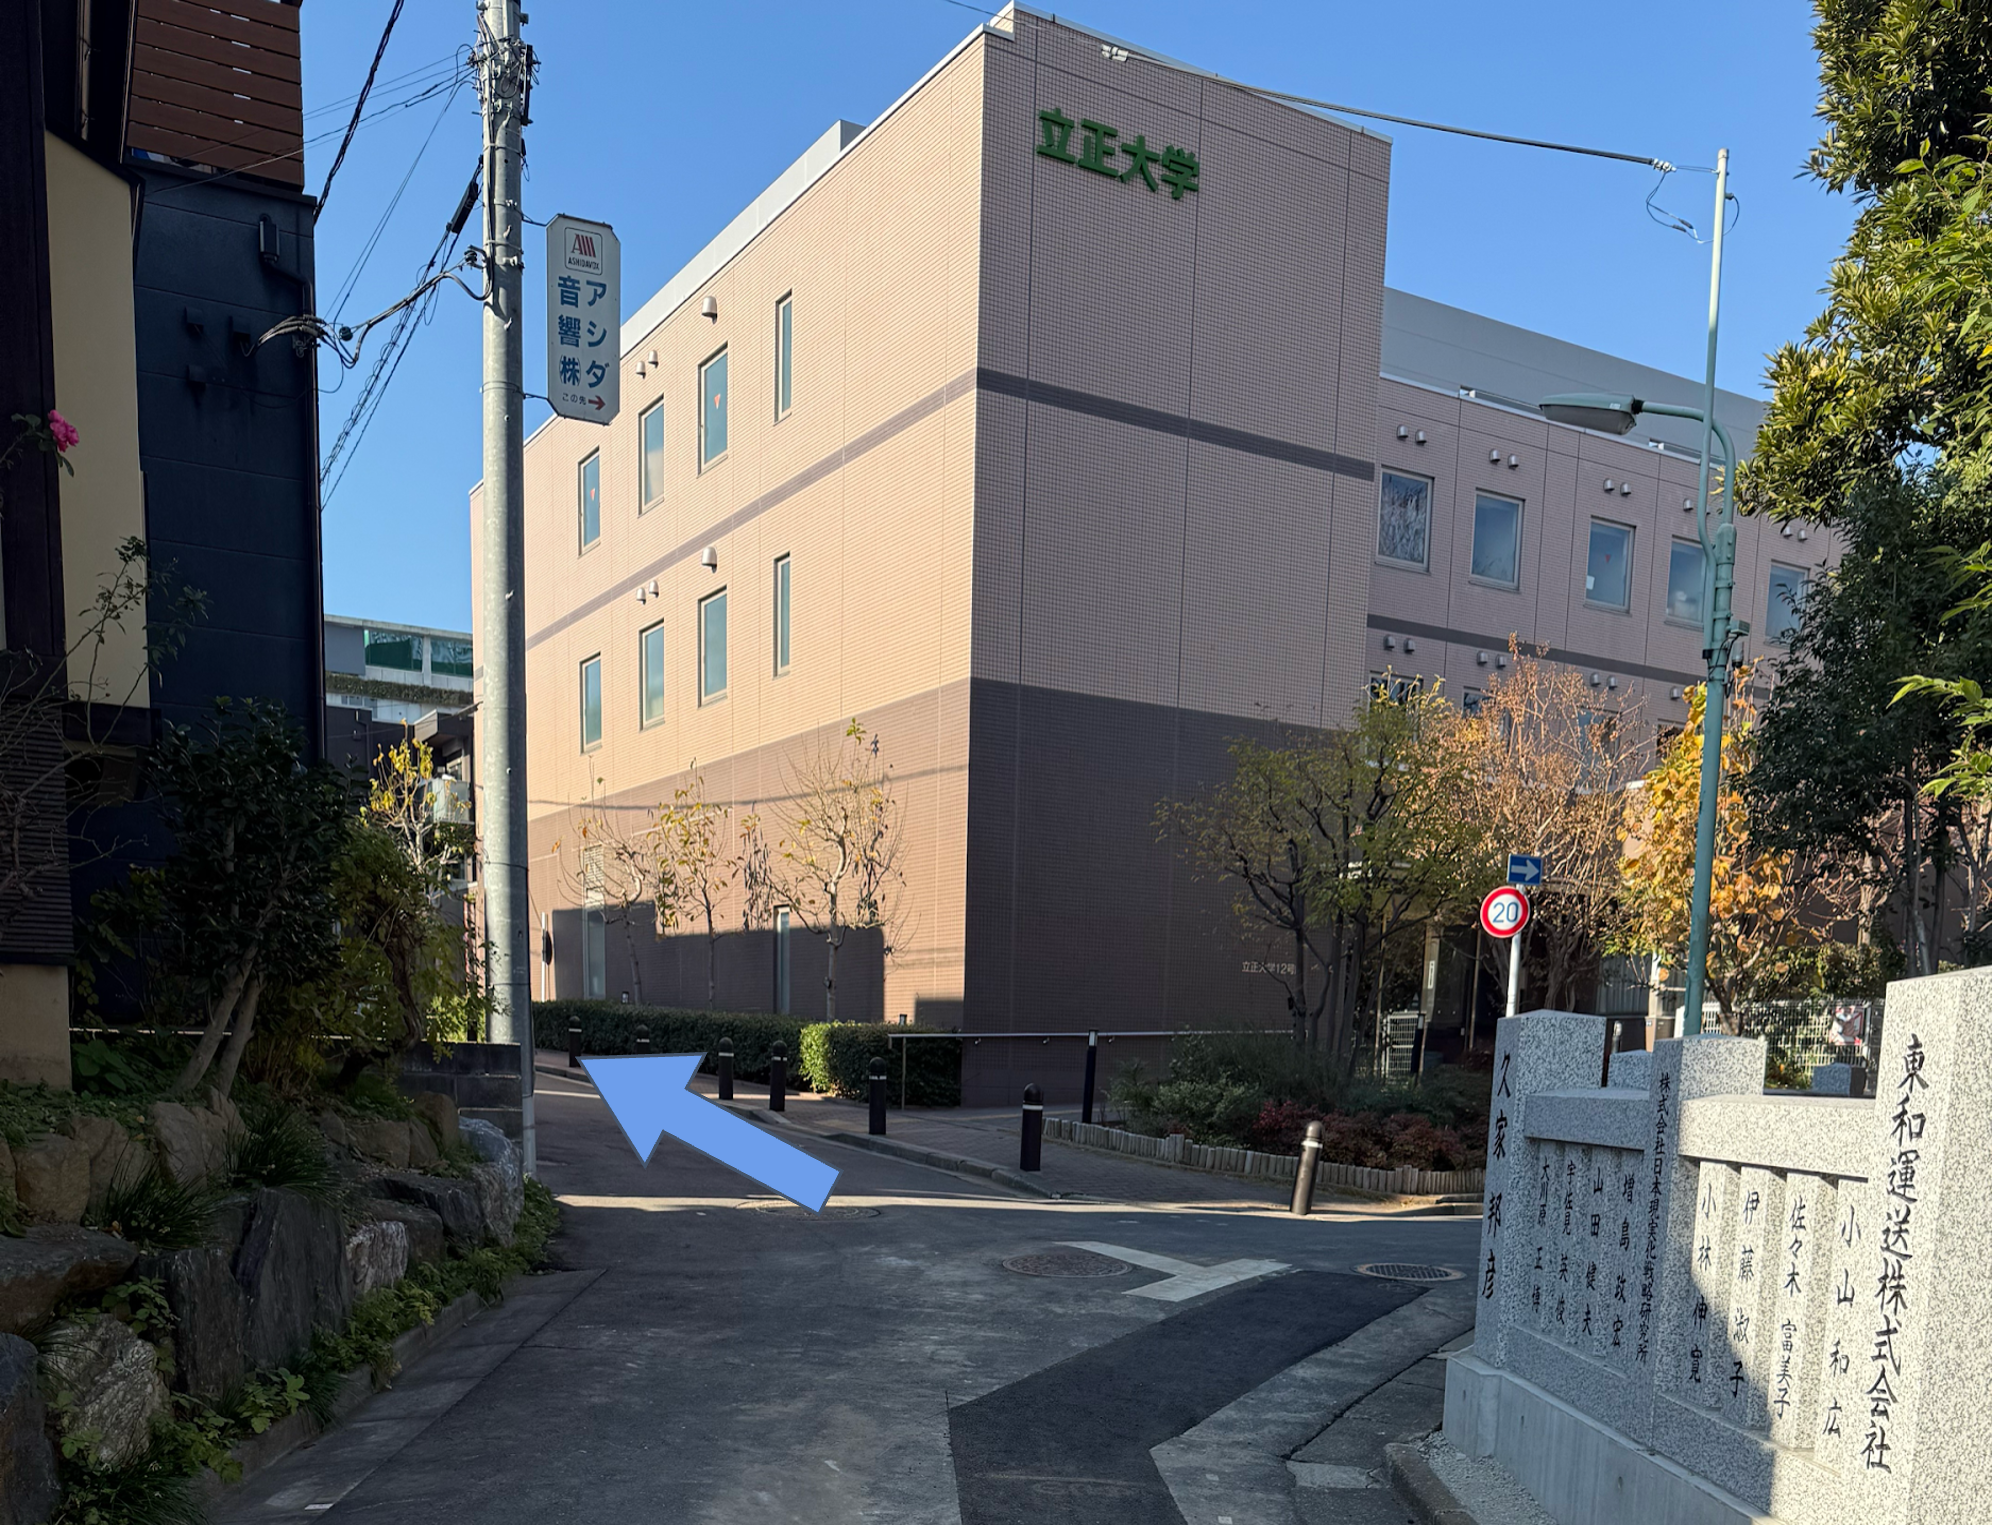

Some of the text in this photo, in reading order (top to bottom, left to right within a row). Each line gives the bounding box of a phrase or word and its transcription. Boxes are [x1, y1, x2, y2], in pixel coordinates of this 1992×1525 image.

[1036, 107, 1199, 200] 立正大学
[568, 256, 600, 270] ASHIDAVOX
[586, 279, 610, 388] アシダ
[562, 392, 587, 405] この先
[1493, 901, 1519, 923] 20
[1242, 961, 1297, 975] 立正大学12号
[1860, 1033, 1930, 1474] 東和運送株式会社
